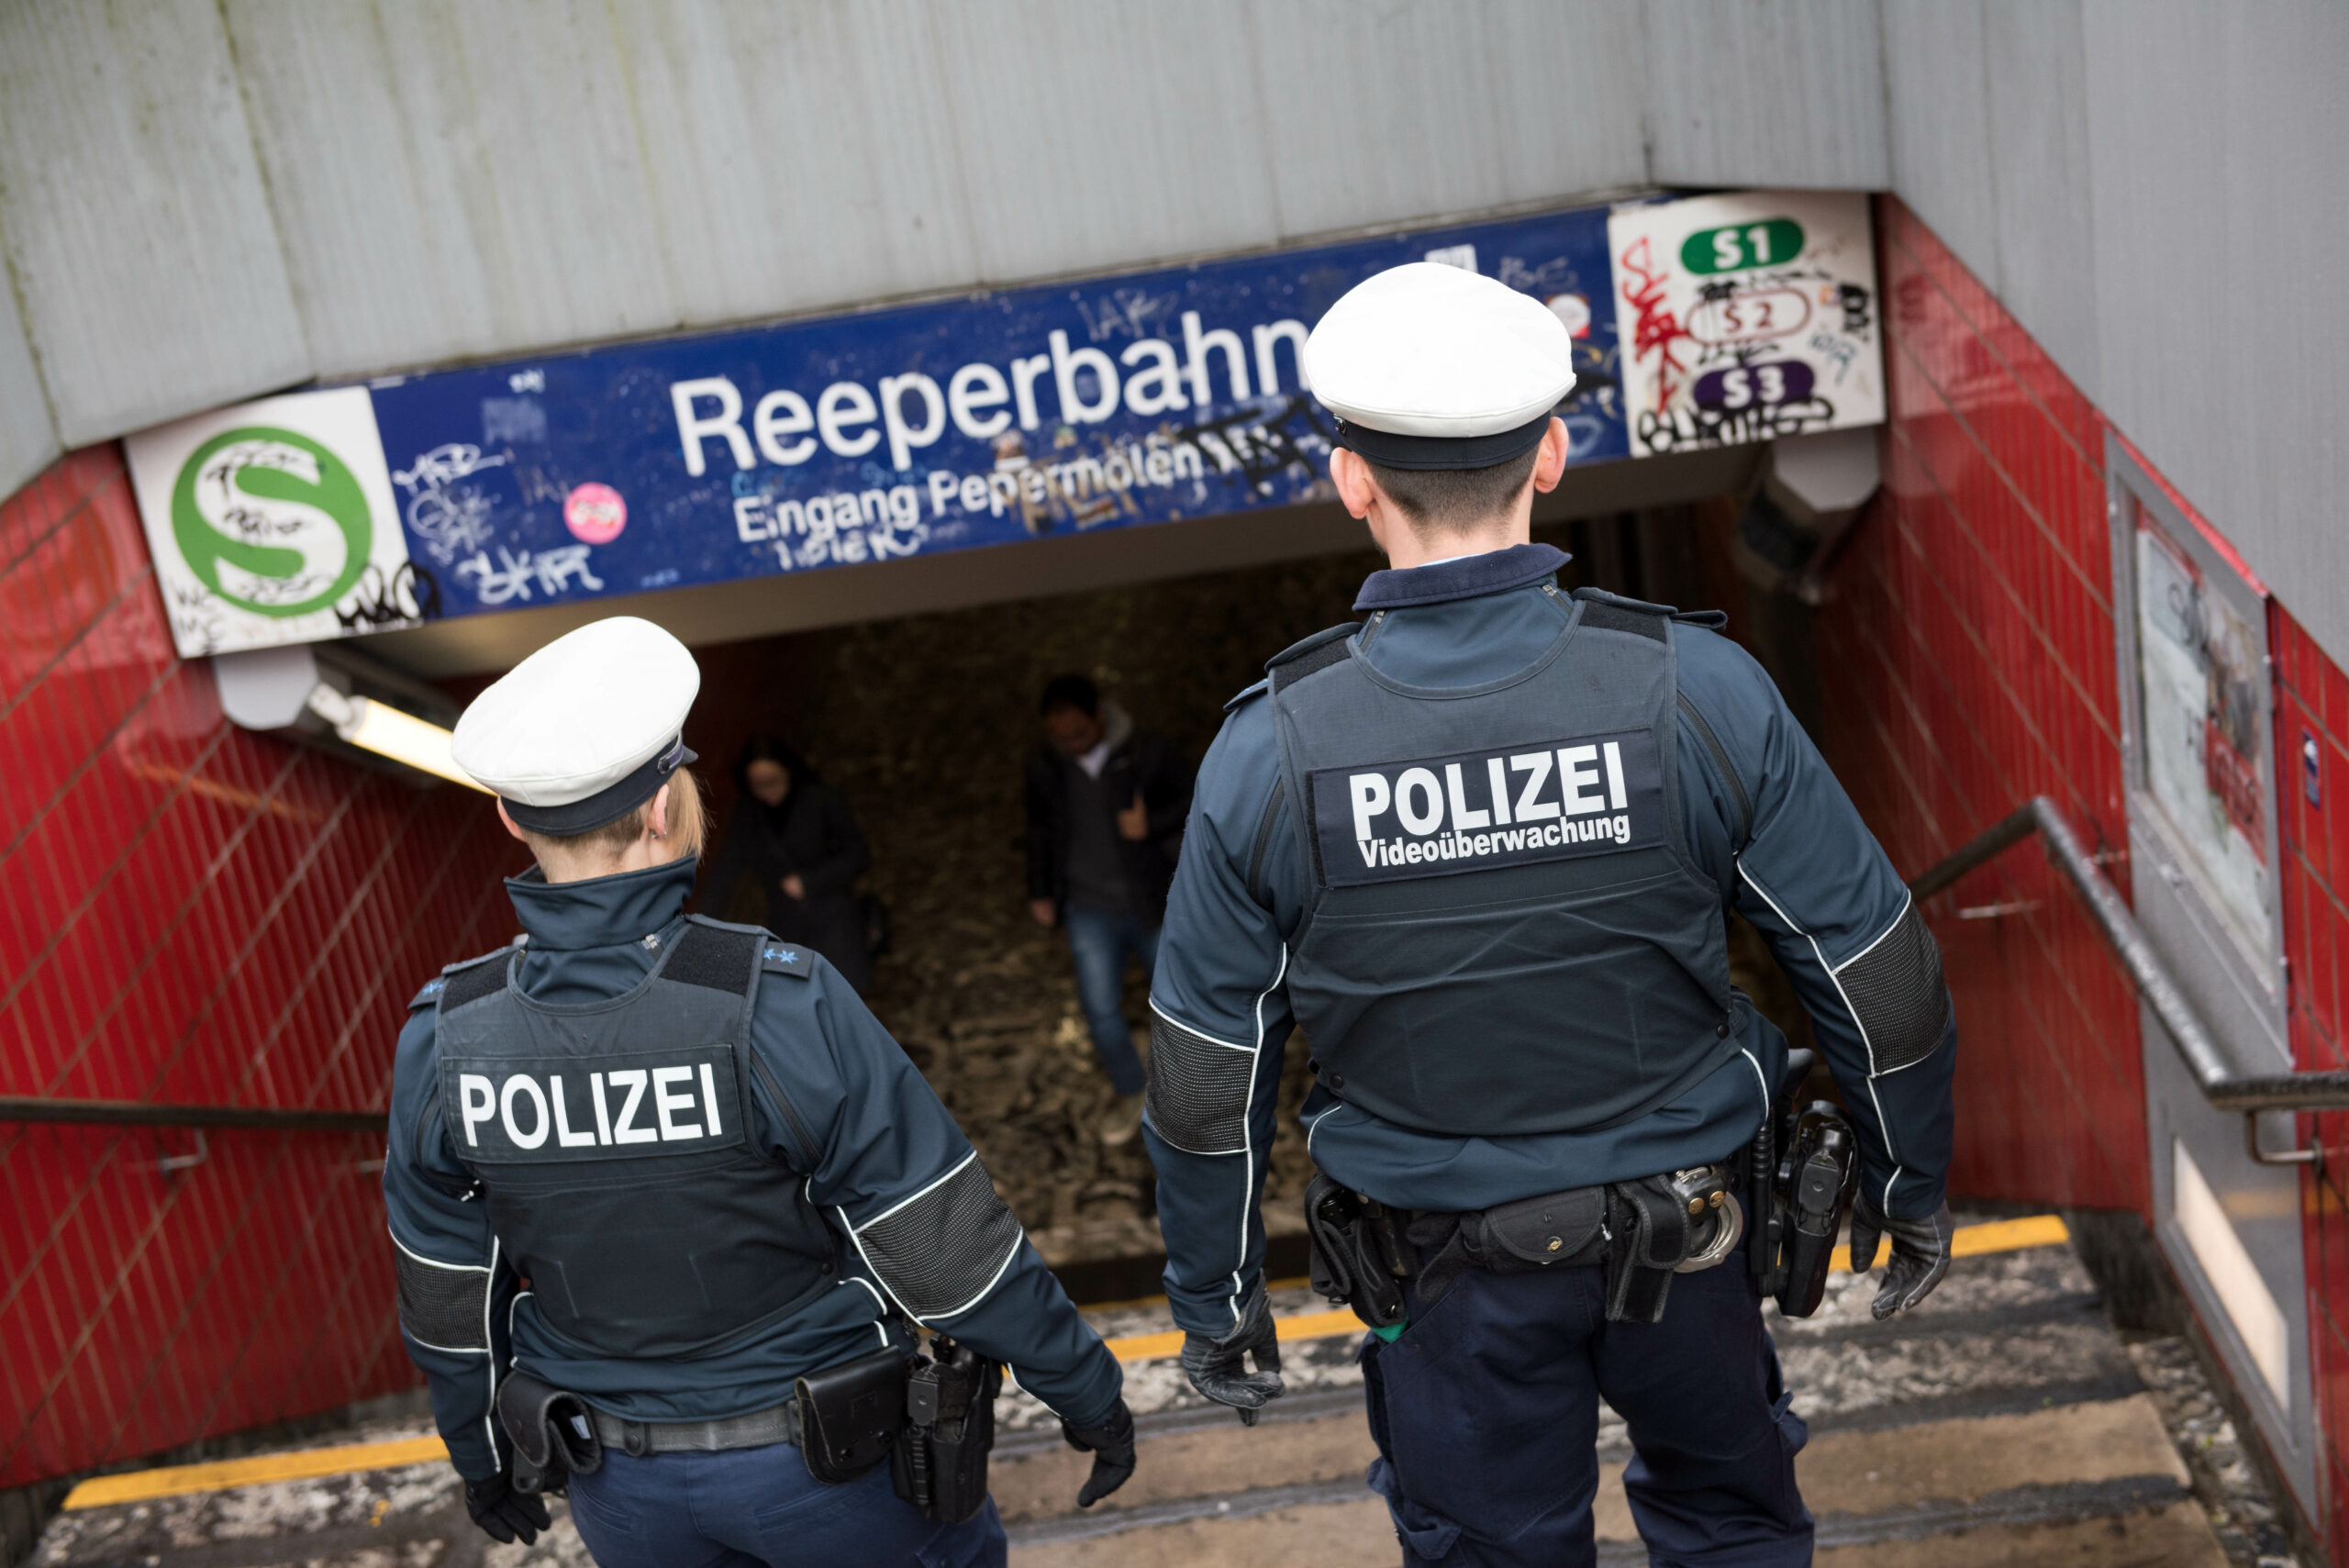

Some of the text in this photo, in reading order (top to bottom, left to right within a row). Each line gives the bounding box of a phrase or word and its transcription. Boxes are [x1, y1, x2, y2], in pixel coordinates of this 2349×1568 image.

[671, 309, 1312, 478] Reeperbahn
[194, 439, 349, 606] S
[734, 465, 919, 543] Eingang
[1349, 741, 1629, 841] POLIZEI
[1358, 814, 1631, 868] Videoüberwachung
[459, 1062, 723, 1151] POLIZEI
